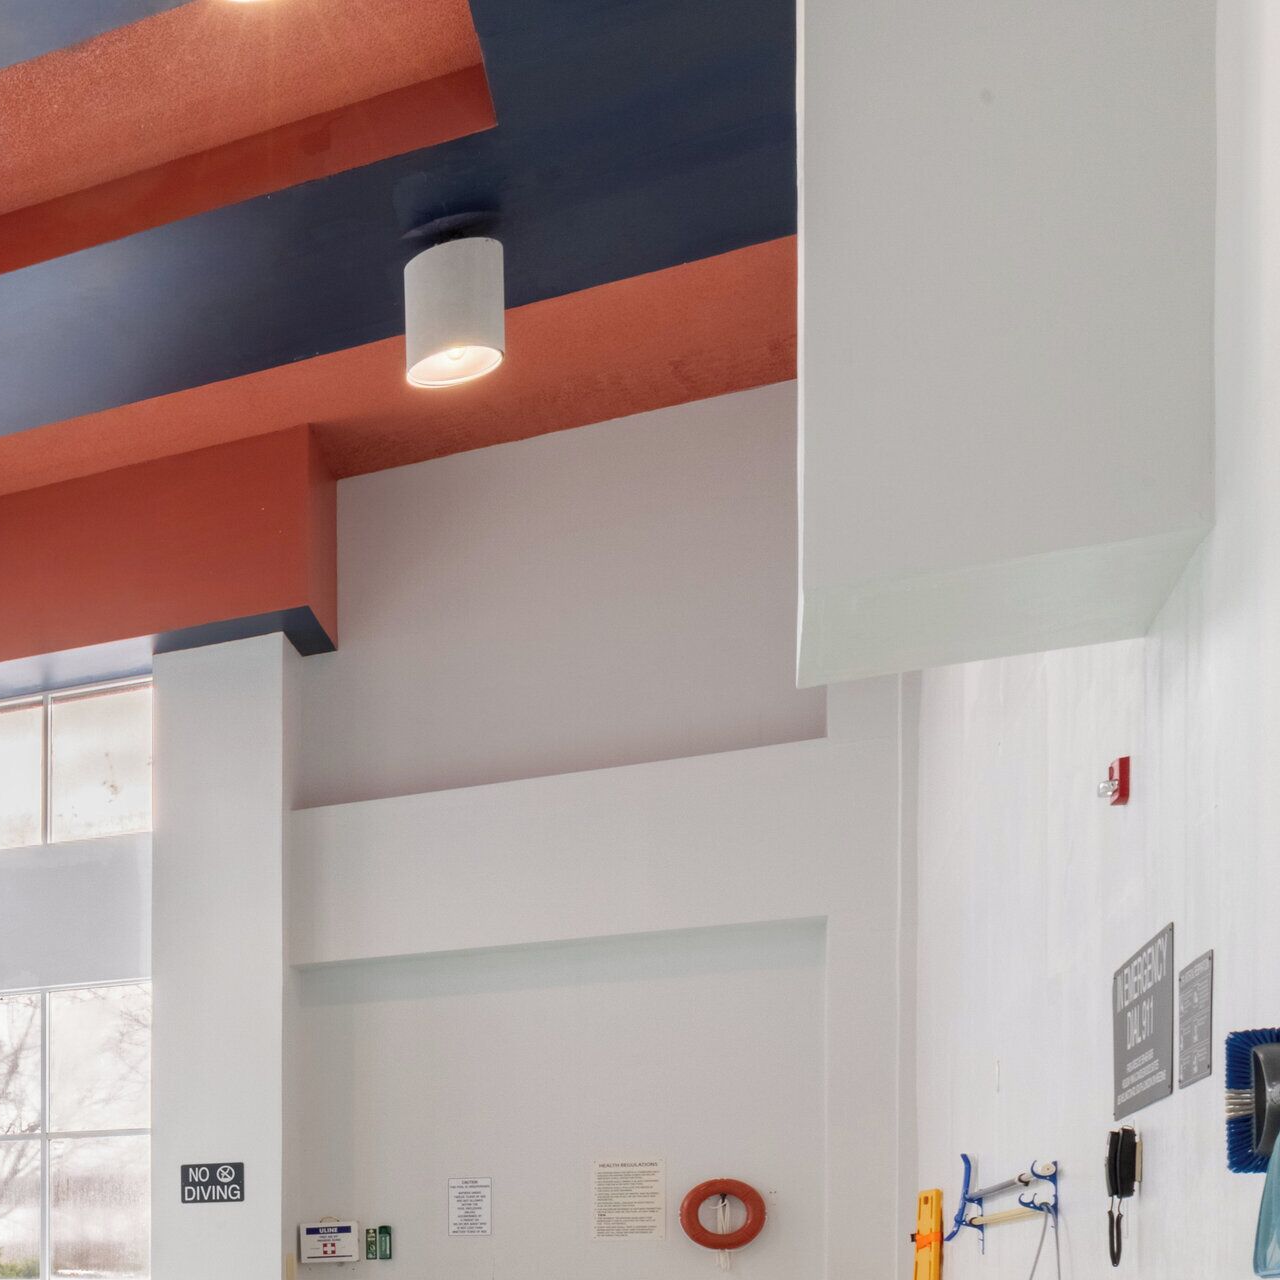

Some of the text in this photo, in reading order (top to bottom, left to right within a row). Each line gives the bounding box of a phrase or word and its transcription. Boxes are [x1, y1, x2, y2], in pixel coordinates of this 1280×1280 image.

[1124, 933, 1168, 1006] EMERGENCY
[1142, 994, 1154, 1041] 911
[189, 1167, 209, 1182] NO
[185, 1184, 241, 1201] DIVING
